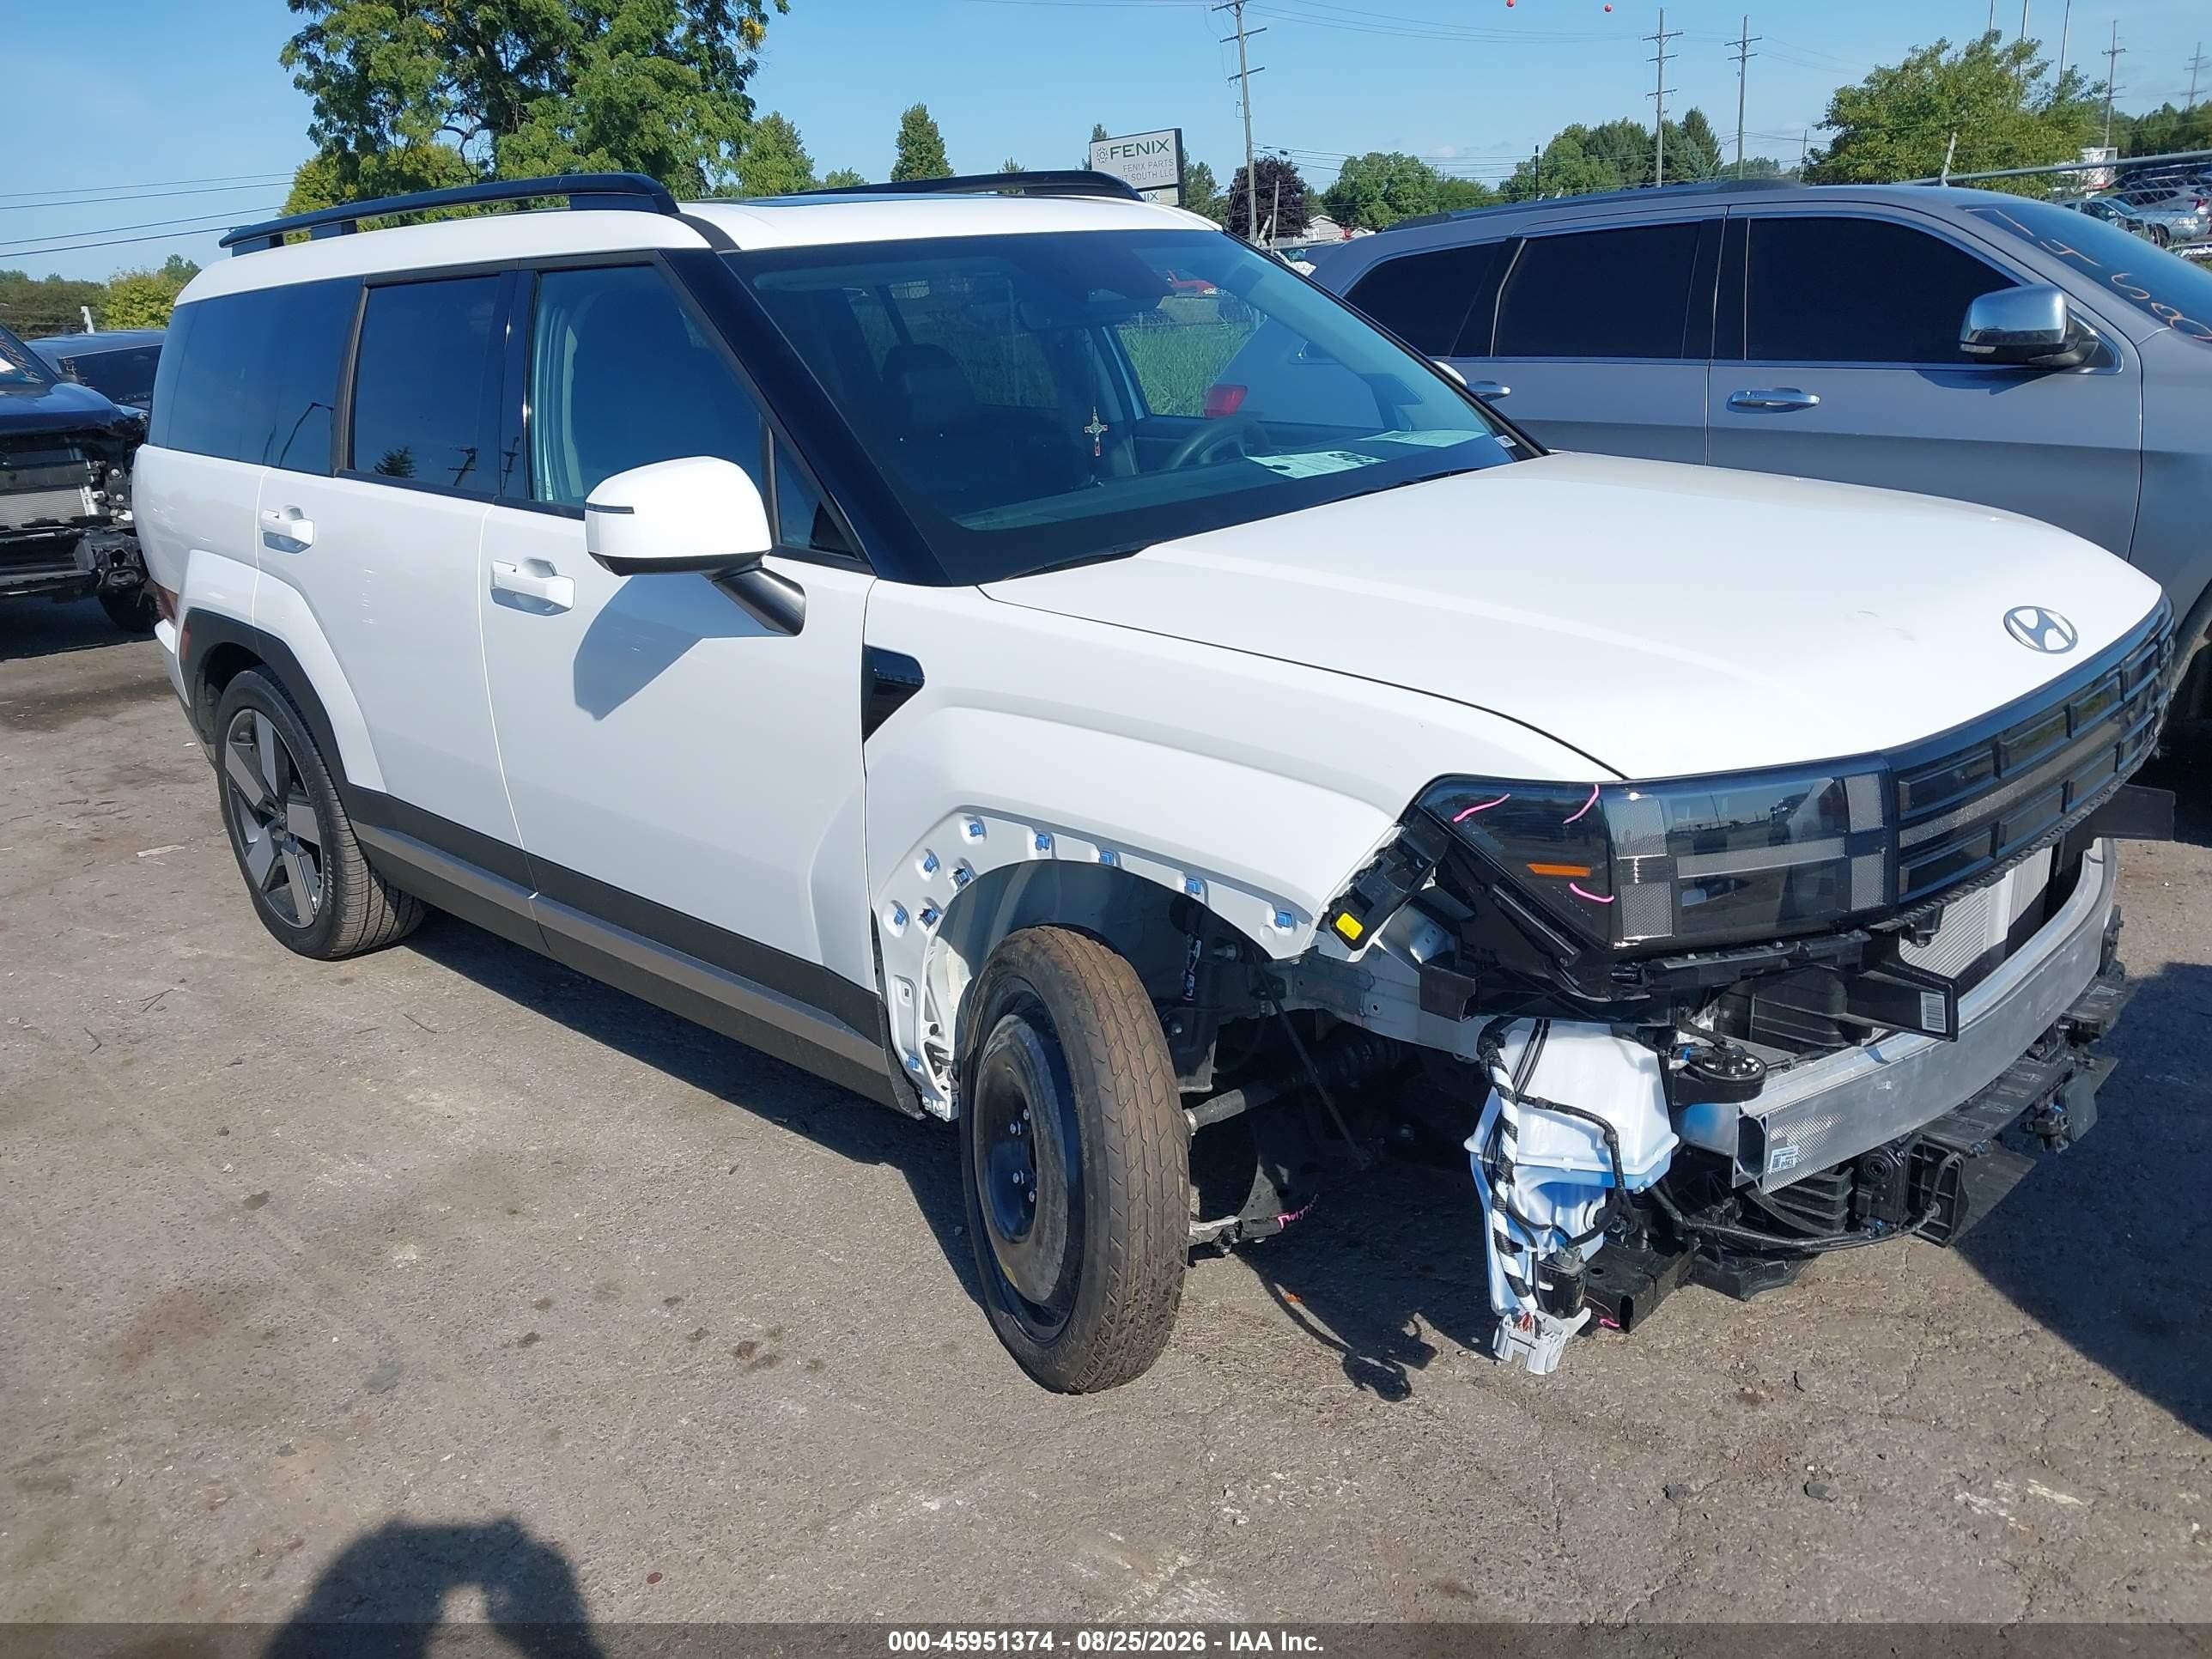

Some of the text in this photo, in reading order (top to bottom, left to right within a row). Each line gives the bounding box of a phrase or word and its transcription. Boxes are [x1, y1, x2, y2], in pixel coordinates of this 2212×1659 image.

[1110, 139, 1170, 160] FENIX
[1123, 158, 1174, 173] FENIX PARTS
[1132, 172, 1157, 181] SOUTH
[1160, 168, 1174, 178] LLC
